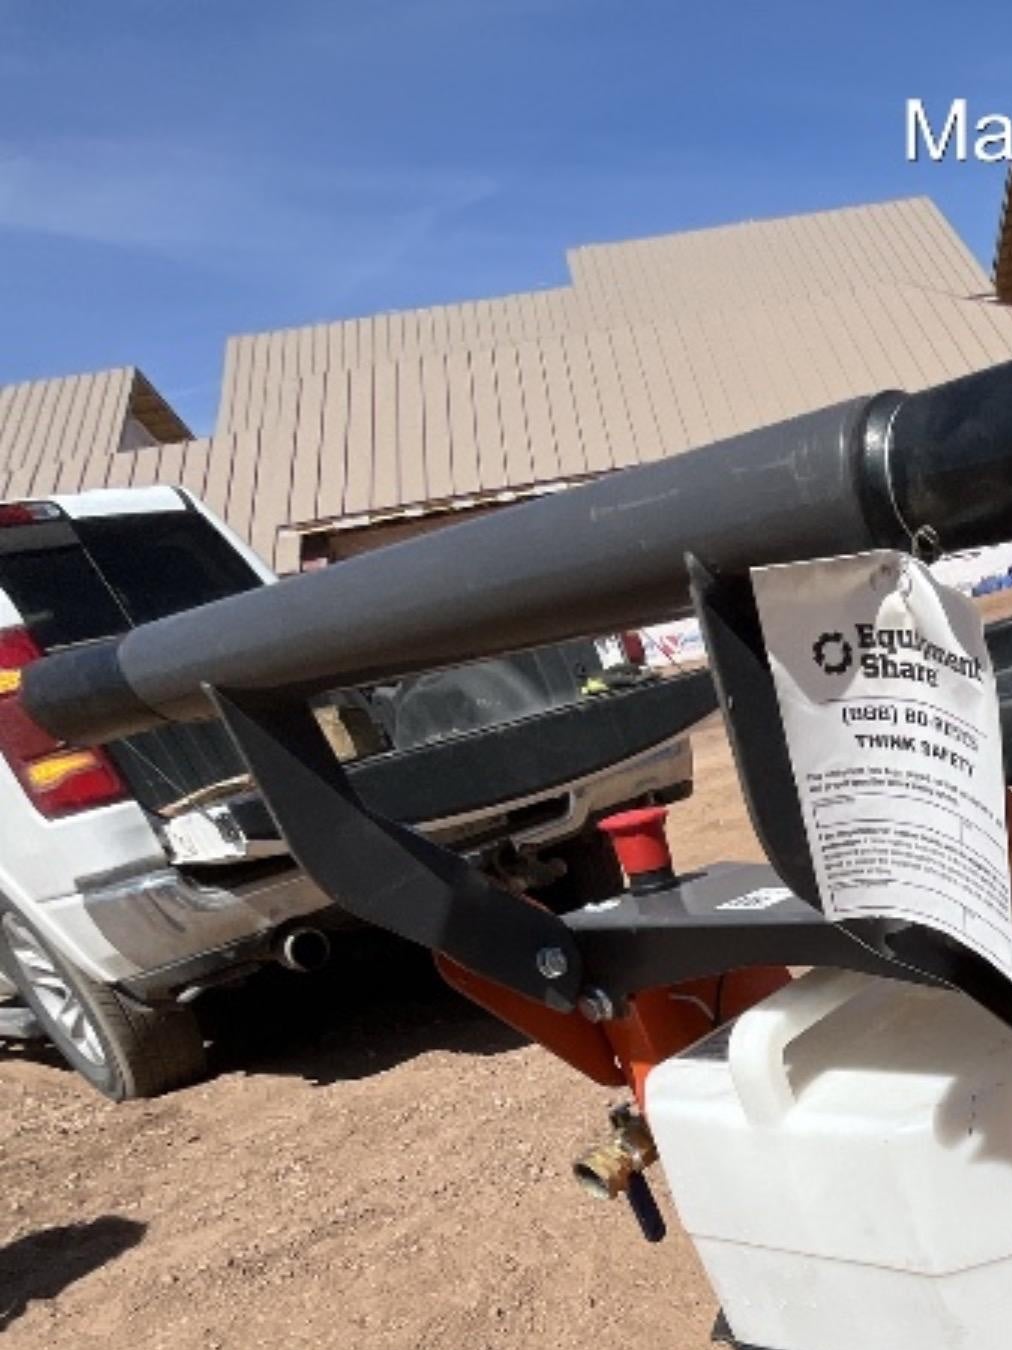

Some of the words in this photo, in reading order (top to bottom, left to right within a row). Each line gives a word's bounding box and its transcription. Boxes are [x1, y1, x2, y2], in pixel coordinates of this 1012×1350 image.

[860, 653, 940, 688] Share
[854, 734, 917, 752] THINK
[920, 740, 975, 777] SAFETY
